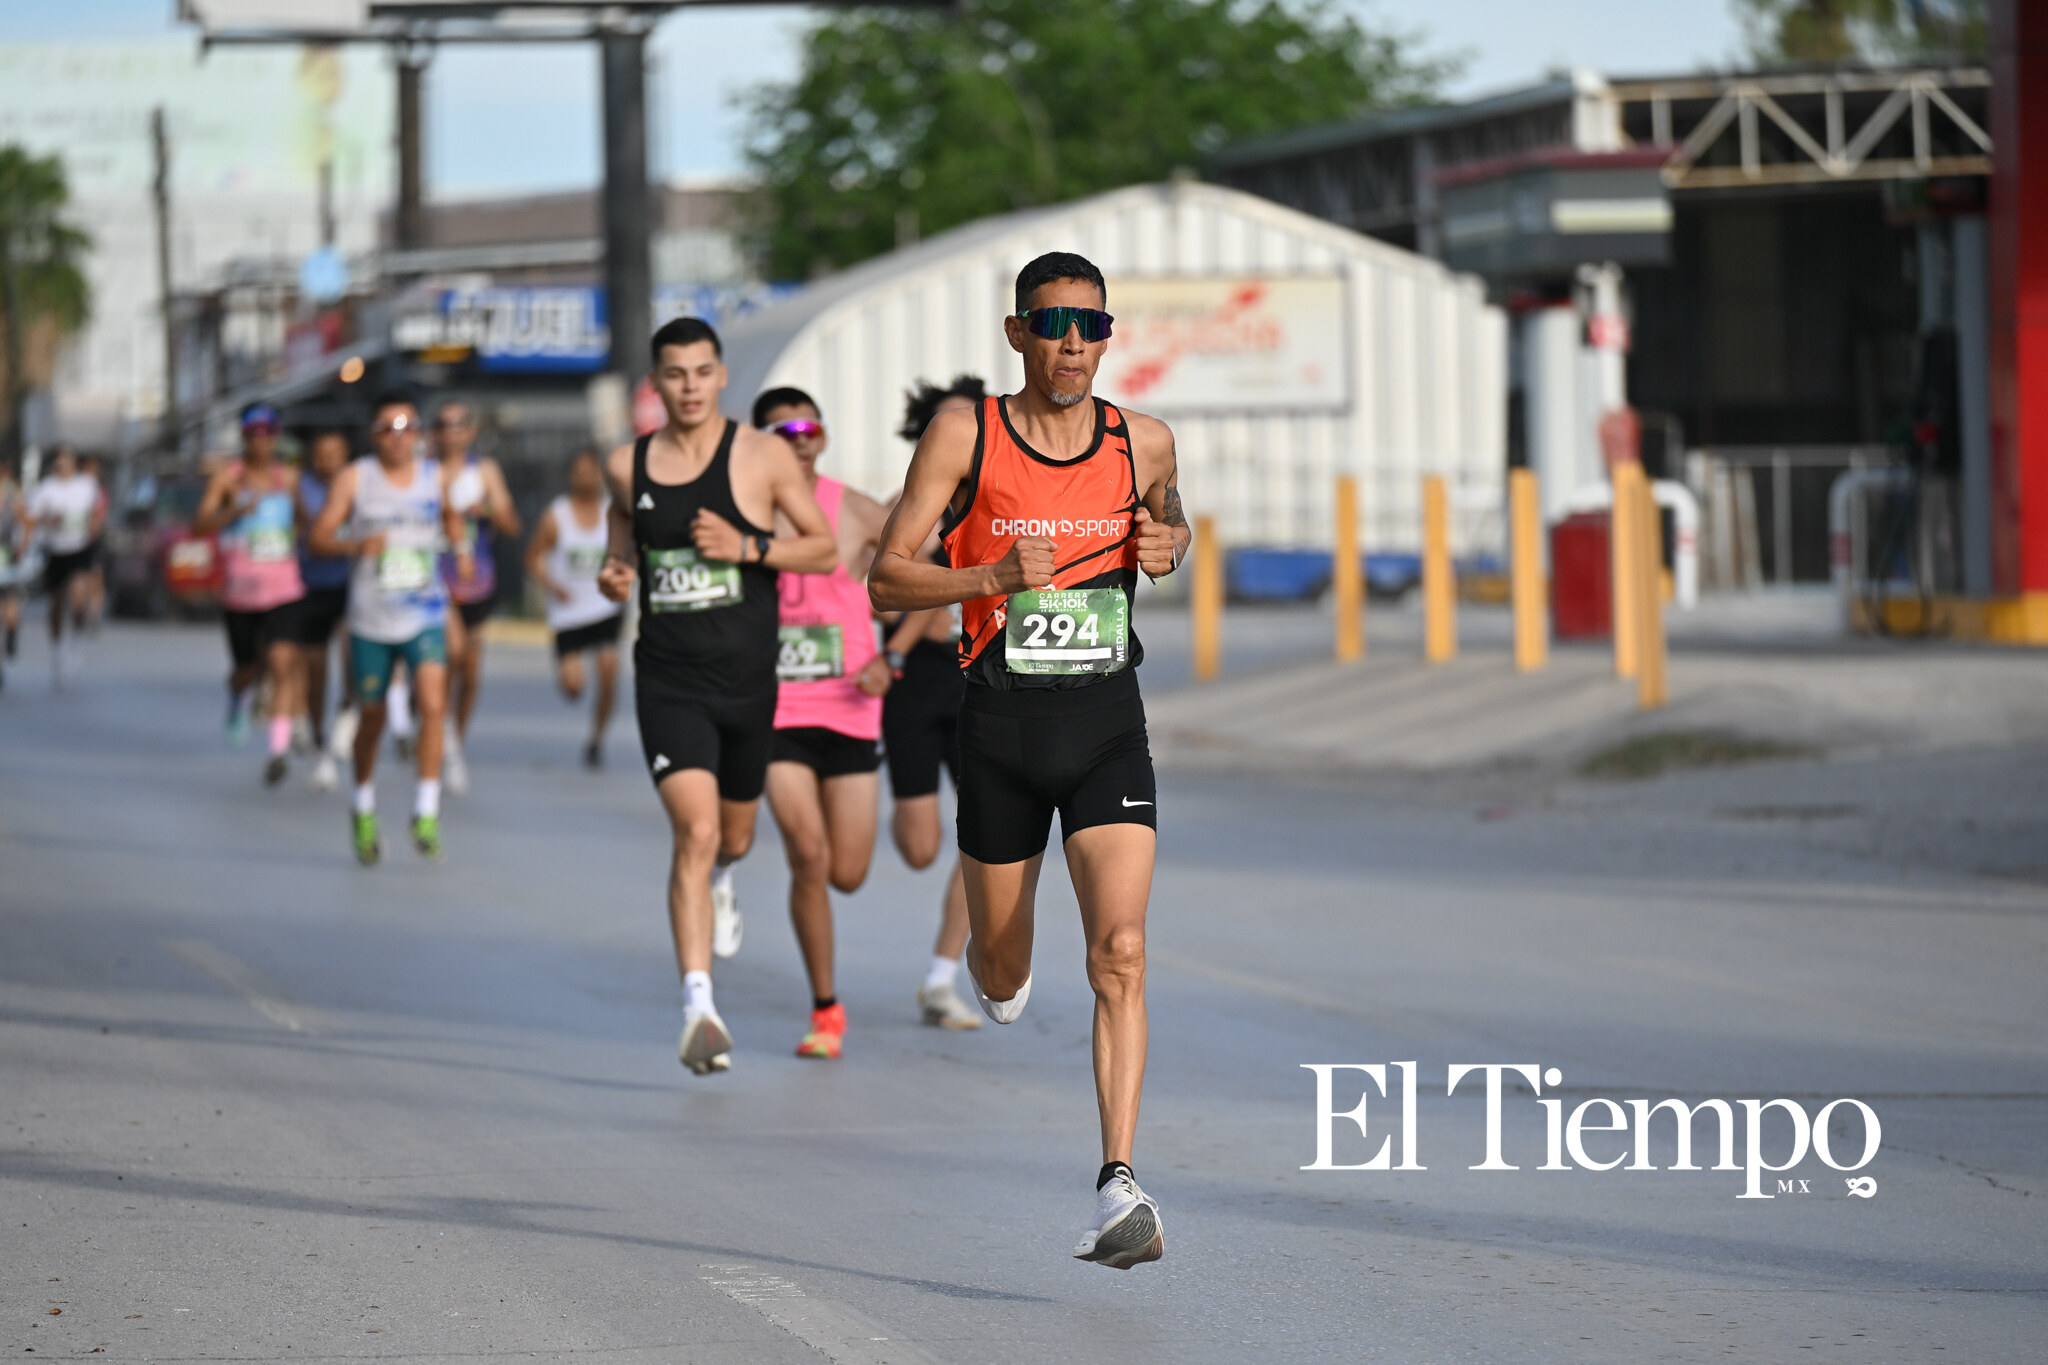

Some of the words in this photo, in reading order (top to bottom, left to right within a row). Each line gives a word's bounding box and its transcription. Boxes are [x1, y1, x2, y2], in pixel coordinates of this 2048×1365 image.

[654, 563, 711, 592] 200
[1022, 613, 1100, 647] 294
[1116, 606, 1125, 662] MEDALLA
